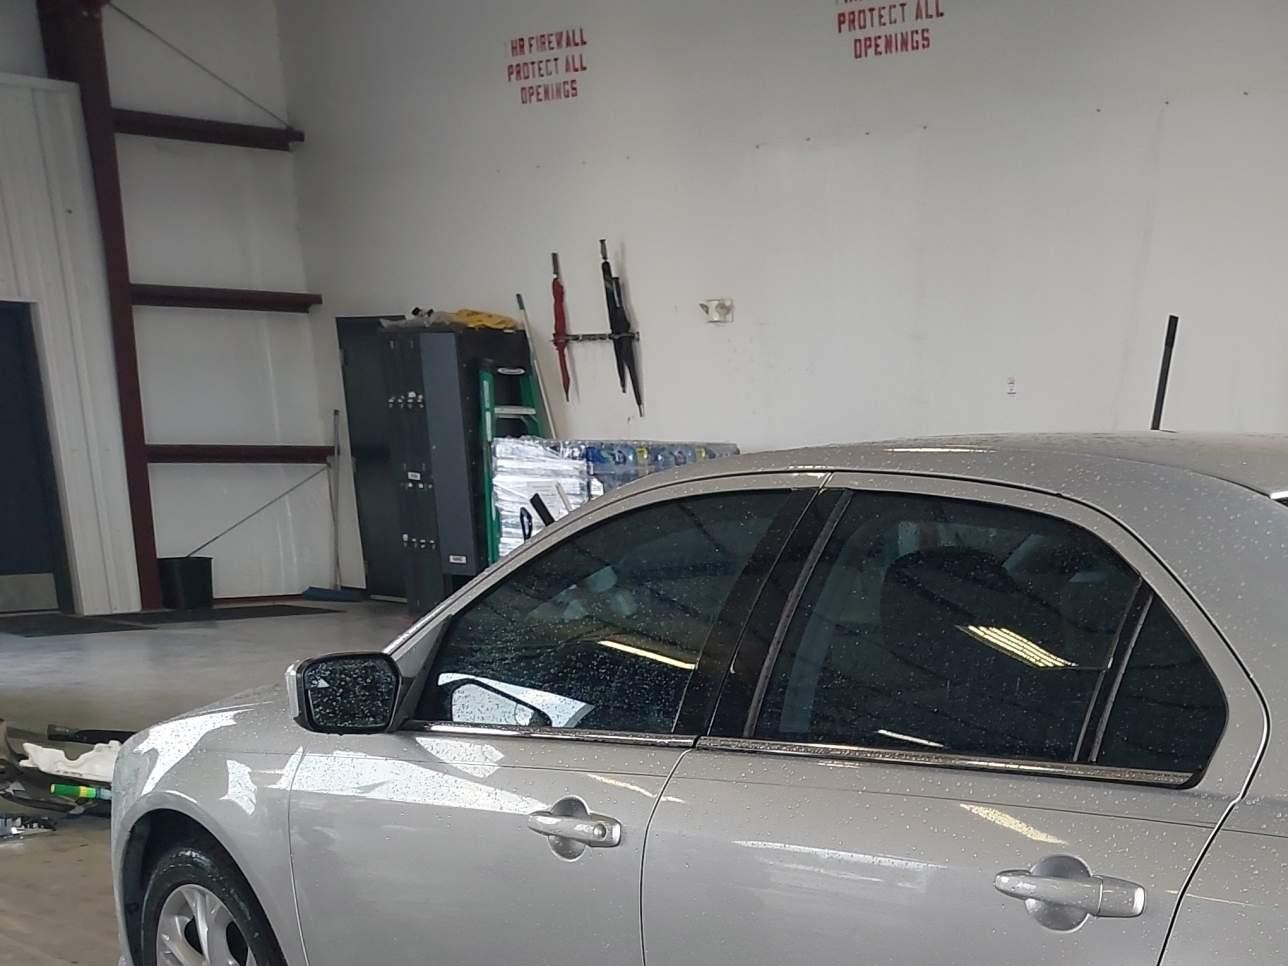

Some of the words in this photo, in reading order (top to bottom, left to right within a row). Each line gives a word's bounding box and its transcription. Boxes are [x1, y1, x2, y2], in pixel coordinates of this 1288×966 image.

[837, 2, 907, 33] PROTECT
[915, 0, 944, 21] ALL
[511, 37, 525, 57] HR
[527, 27, 587, 54] FIREWALL
[853, 28, 930, 59] OPENINGS
[507, 57, 559, 82] PROTECT
[565, 53, 587, 73] ALL
[520, 79, 578, 104] OPENINGS
